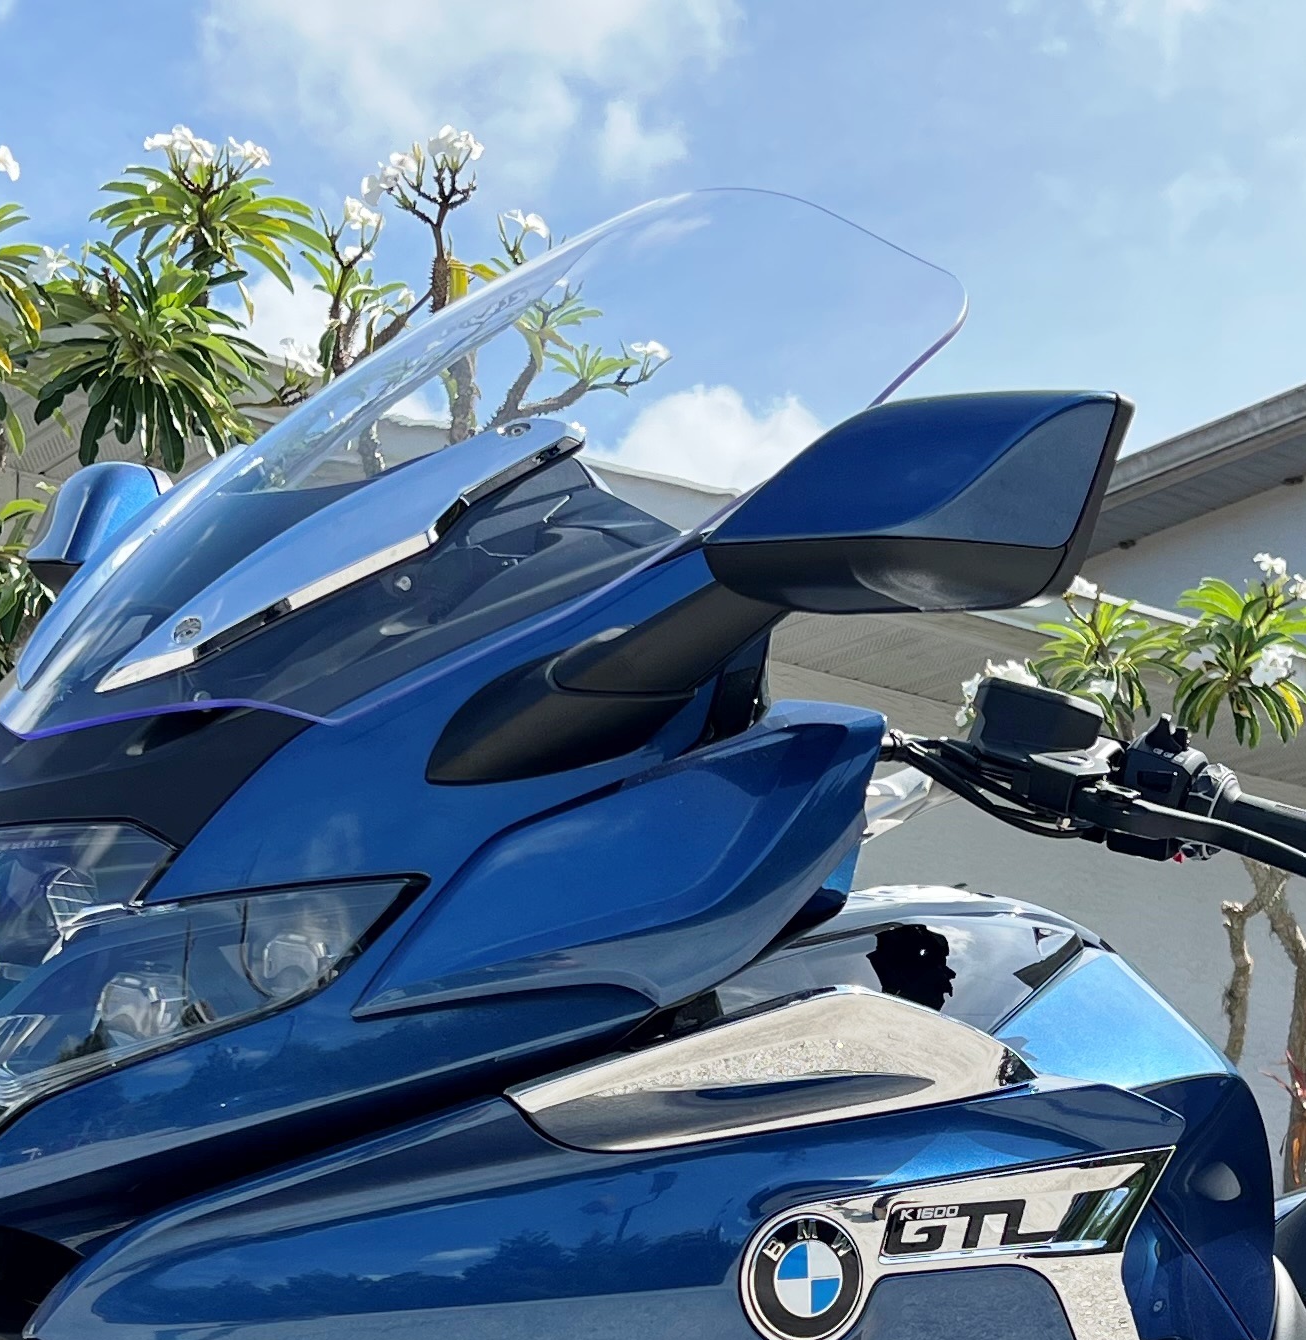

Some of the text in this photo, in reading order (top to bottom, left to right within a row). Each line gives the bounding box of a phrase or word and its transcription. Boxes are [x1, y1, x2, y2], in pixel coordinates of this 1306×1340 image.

[884, 1199, 1063, 1254] GTL
[899, 1206, 960, 1221] K 1600
[762, 1217, 853, 1262] BMW
